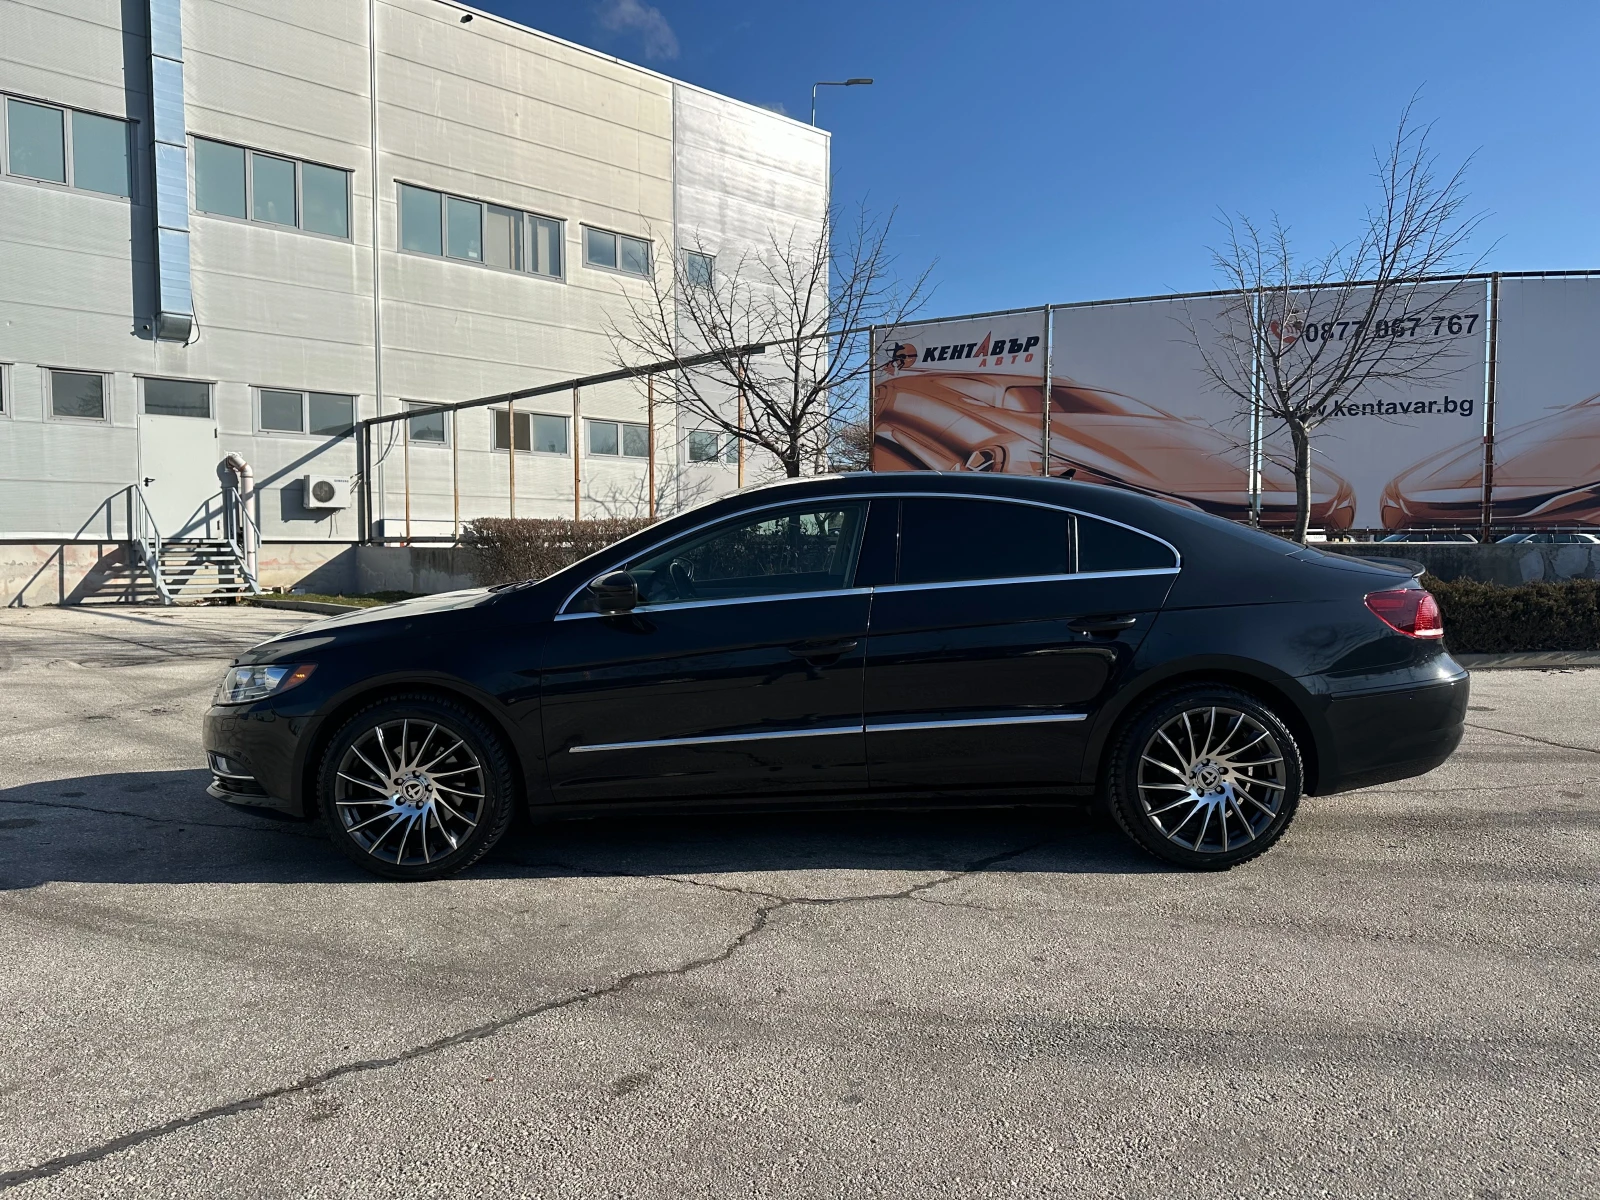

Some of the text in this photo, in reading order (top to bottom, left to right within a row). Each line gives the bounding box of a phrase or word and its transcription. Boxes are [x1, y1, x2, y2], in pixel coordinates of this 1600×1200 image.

[1431, 314, 1479, 336] 767
[922, 331, 1040, 363] КЕНТАВЪР
[979, 353, 1034, 367] АВТО
